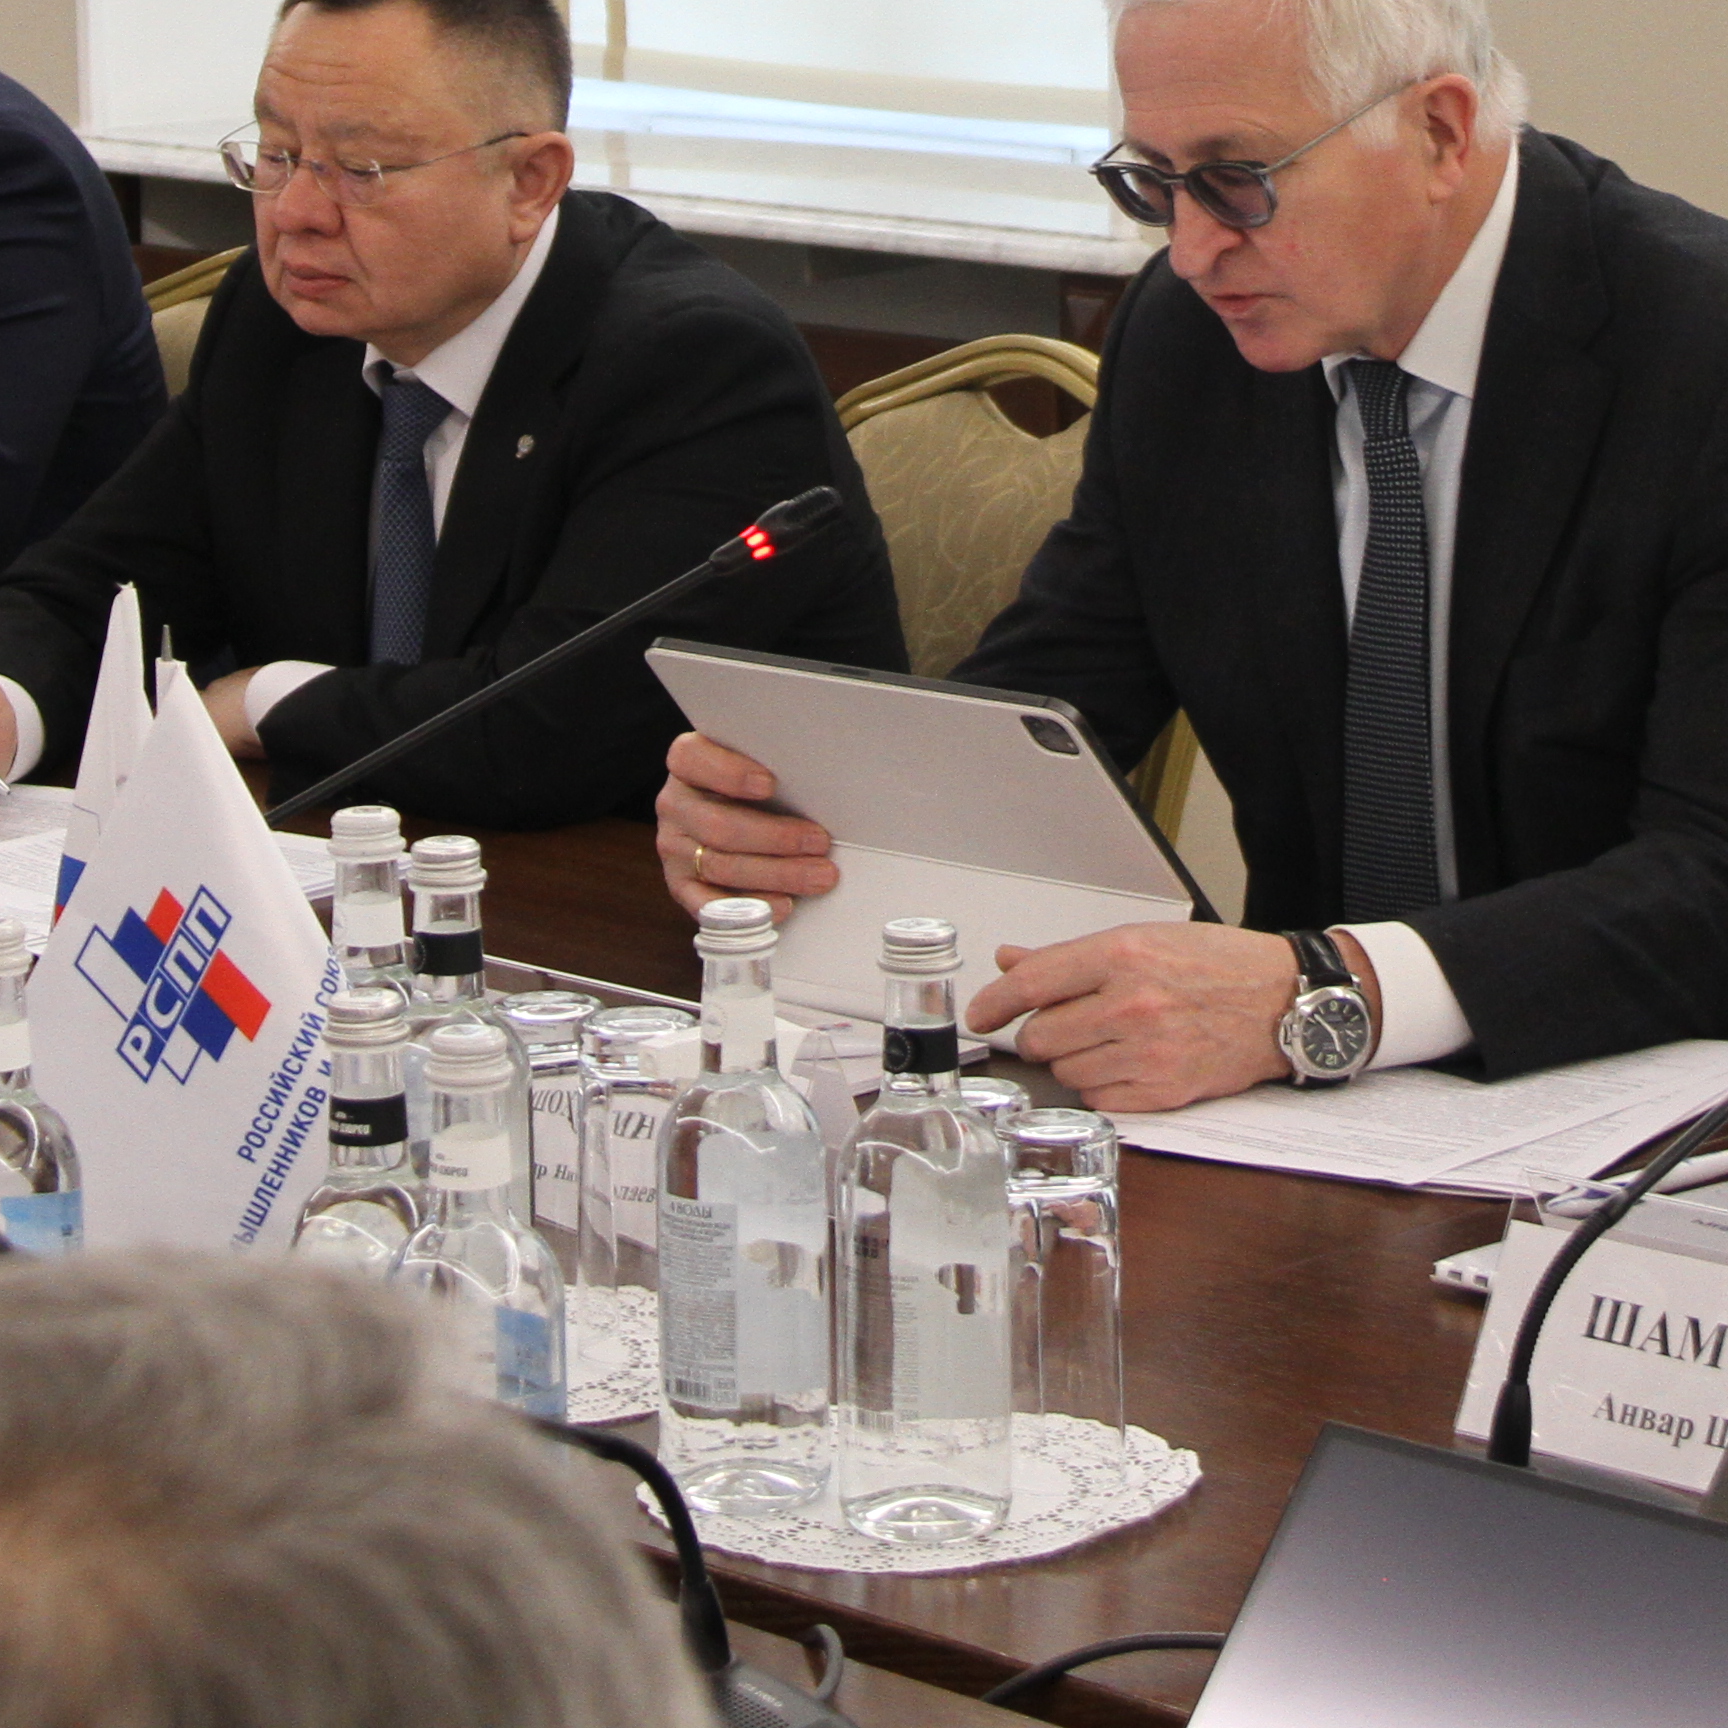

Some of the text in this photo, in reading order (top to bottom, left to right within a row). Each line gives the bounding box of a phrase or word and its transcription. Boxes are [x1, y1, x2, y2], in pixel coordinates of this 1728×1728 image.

[117, 886, 230, 1082] РСПП
[237, 1012, 325, 1163] РОССИЙСКИЙ
[233, 1085, 327, 1247] ЫШЛЕННИКОВ
[1592, 1392, 1695, 1449] Анвар
